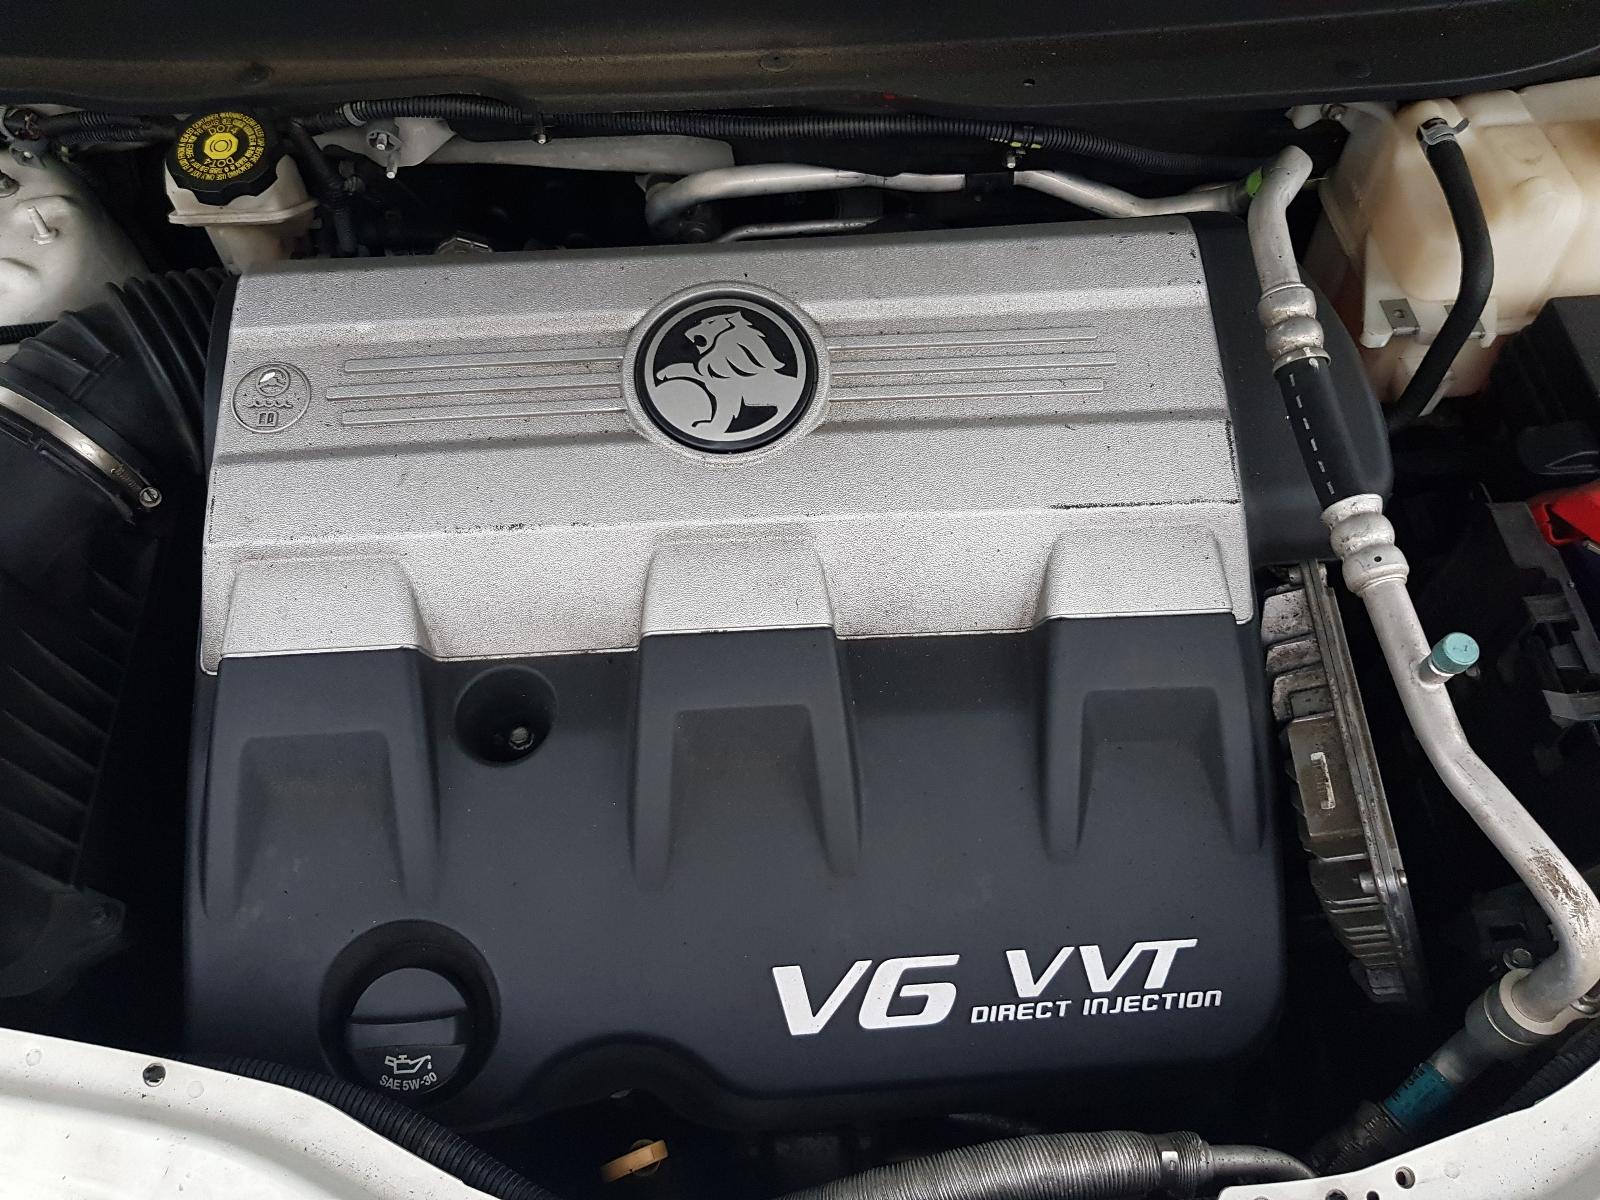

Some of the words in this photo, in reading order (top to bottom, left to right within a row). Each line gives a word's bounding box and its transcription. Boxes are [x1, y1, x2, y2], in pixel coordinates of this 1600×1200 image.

[772, 954, 960, 1036] V6
[1006, 938, 1198, 998] VVT
[970, 1000, 1072, 1023] DIRECT
[1082, 990, 1222, 1016] INJECTION
[379, 1074, 401, 1091] SAE
[402, 1072, 438, 1091] 5W-30
